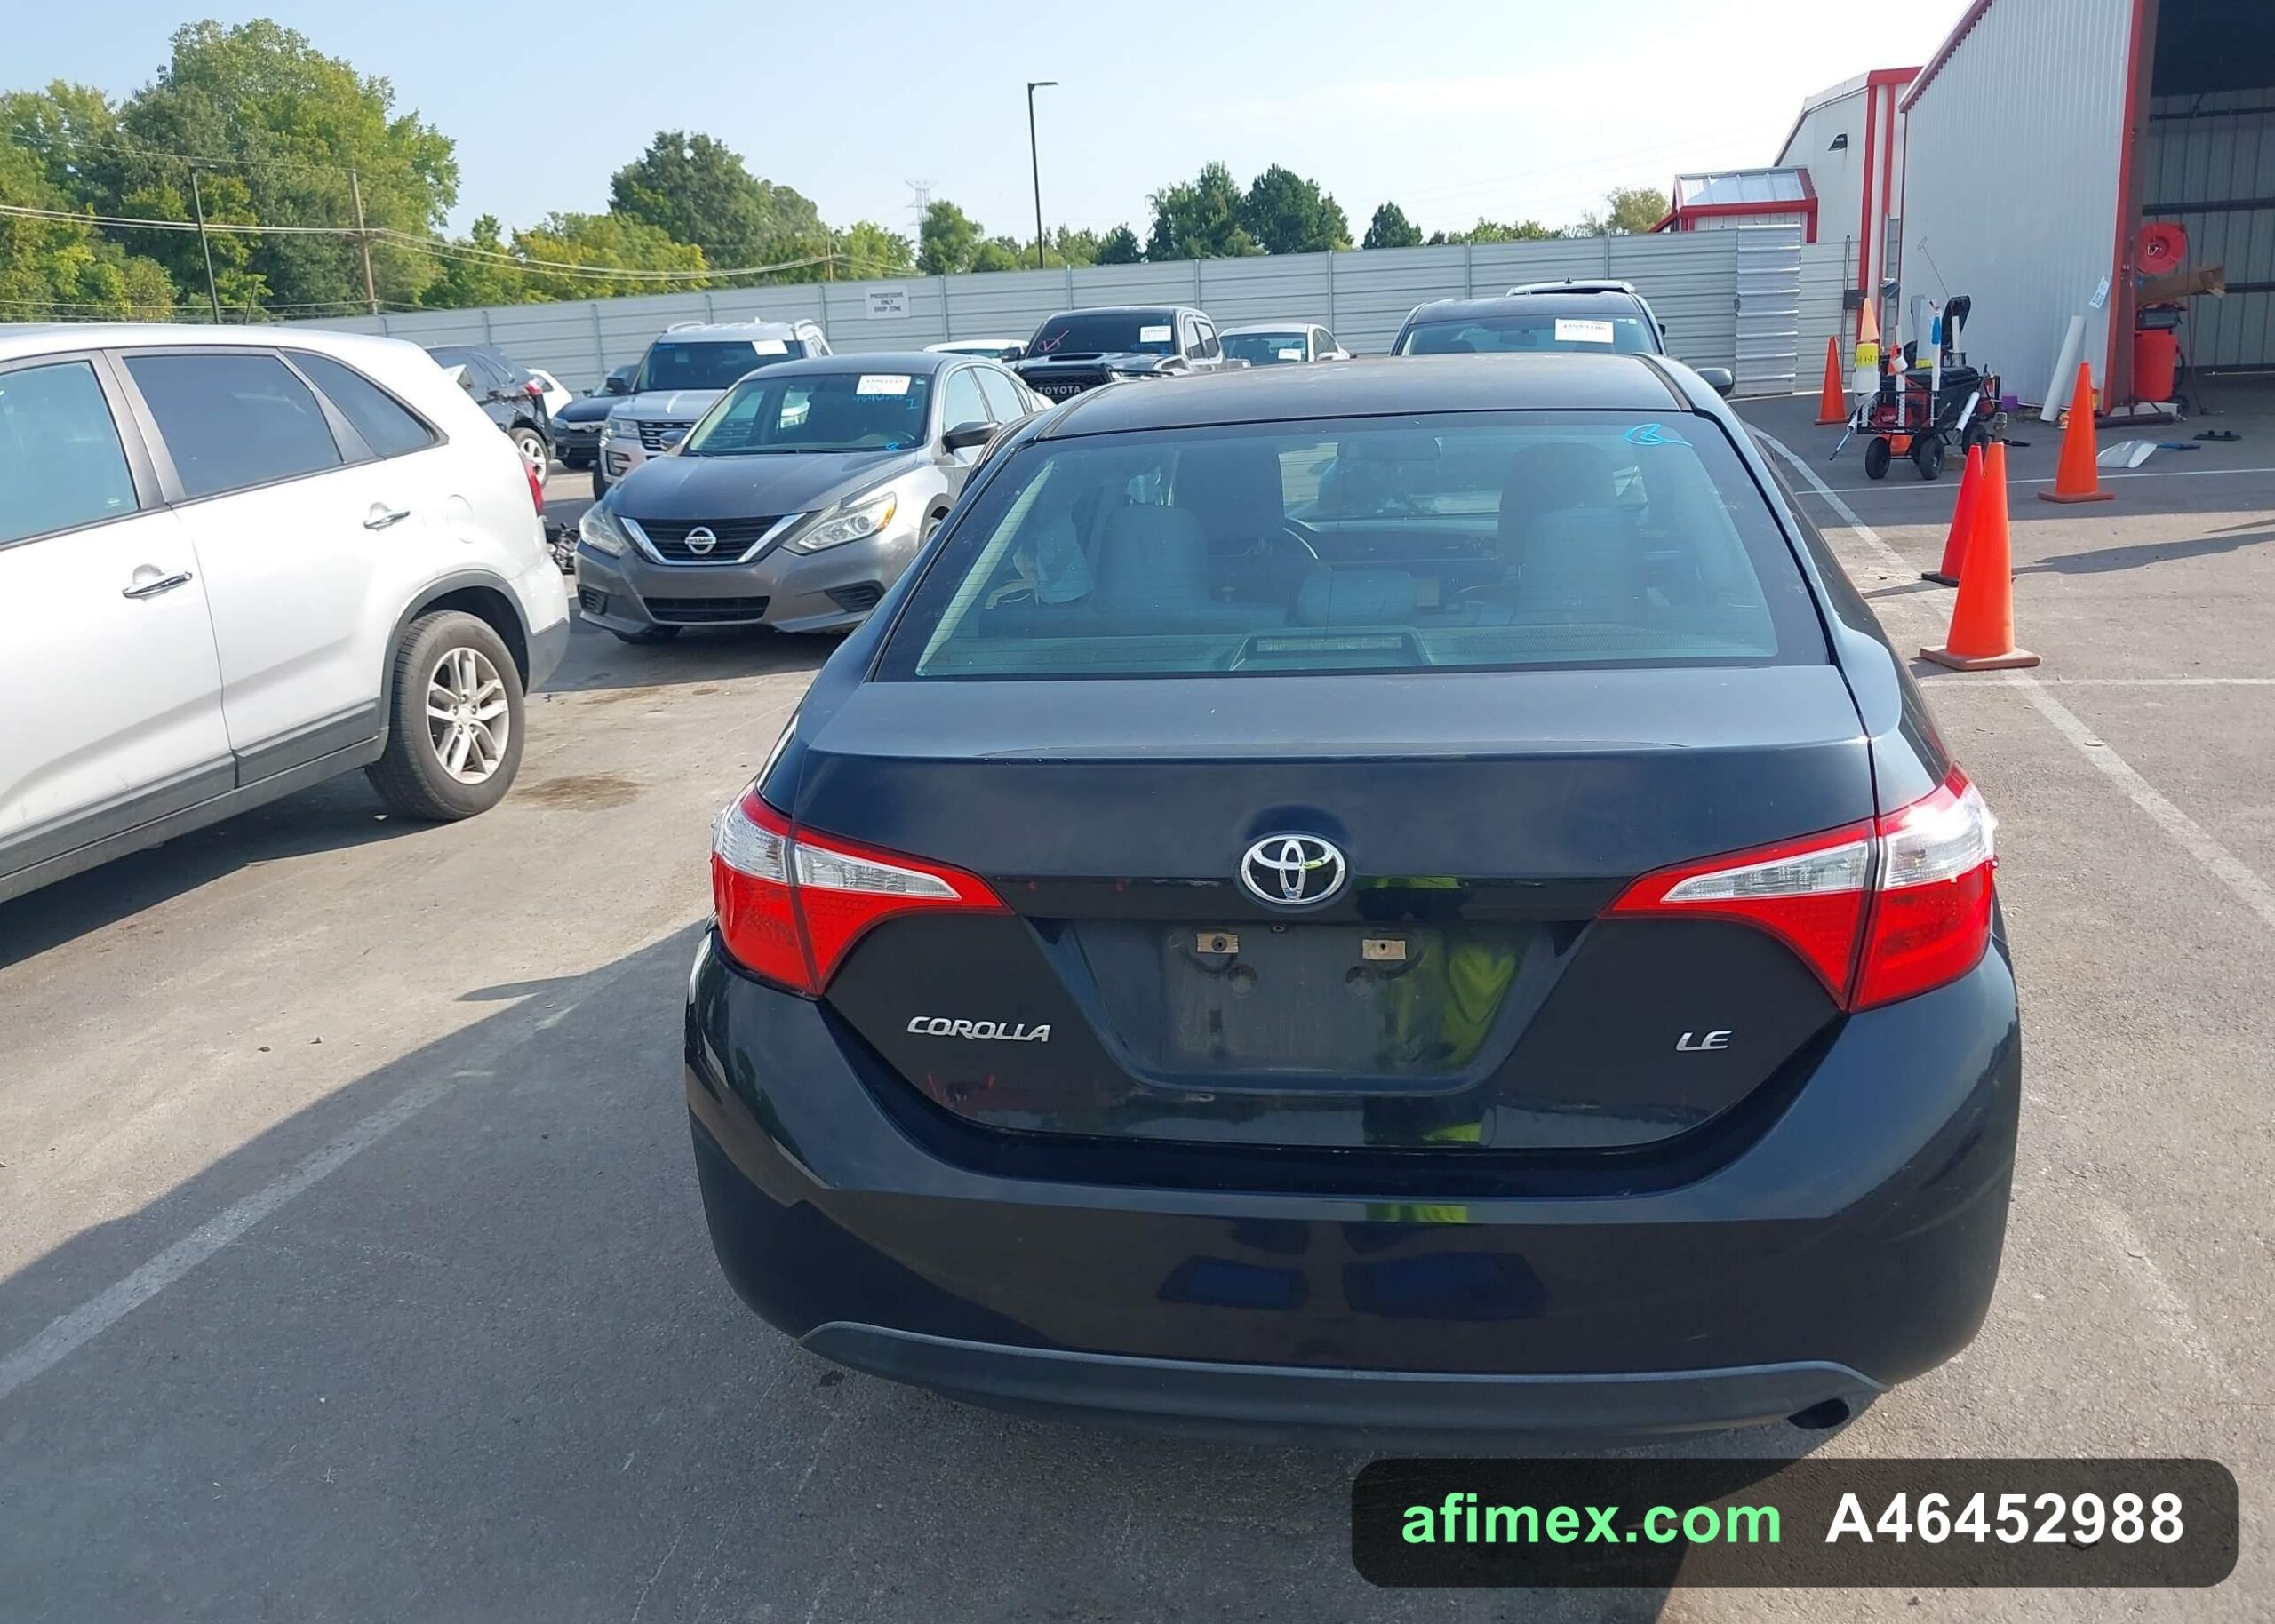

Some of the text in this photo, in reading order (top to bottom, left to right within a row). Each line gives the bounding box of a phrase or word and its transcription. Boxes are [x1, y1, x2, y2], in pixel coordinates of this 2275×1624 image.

[1038, 386, 1082, 395] TOYOTA
[906, 1015, 1051, 1042] COROLLA
[1675, 1030, 1733, 1051] LE
